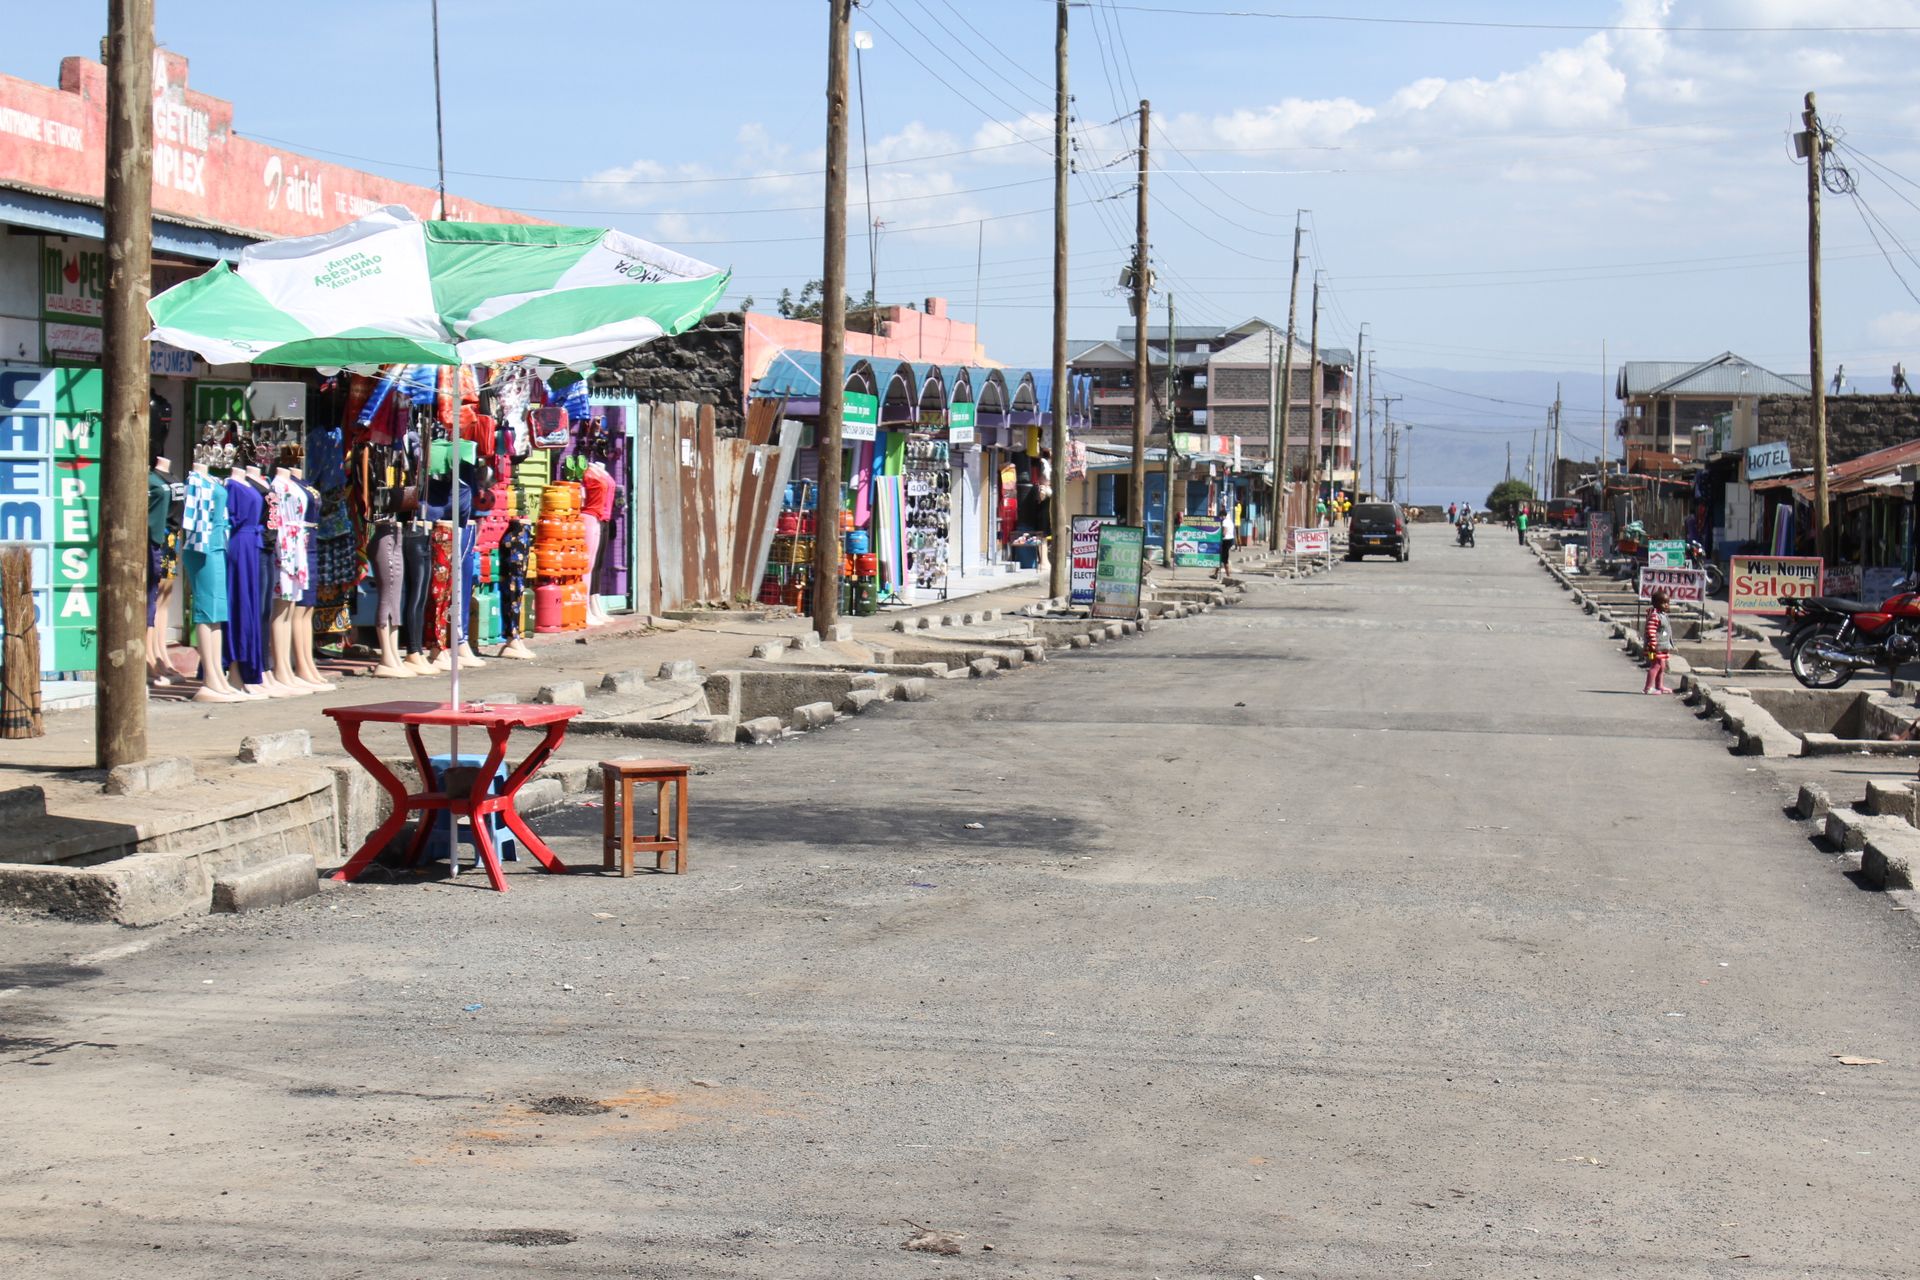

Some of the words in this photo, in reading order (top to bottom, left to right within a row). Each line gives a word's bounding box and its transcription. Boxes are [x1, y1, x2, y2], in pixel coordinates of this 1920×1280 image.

[285, 165, 324, 219] airtel
[350, 254, 383, 272] own
[360, 265, 383, 278] Pay
[314, 267, 350, 287] easy
[1747, 450, 1788, 470] HOTEL
[910, 483, 928, 494] 400
[1296, 531, 1328, 543] CHEMIST
[1112, 548, 1140, 563] KCB
[1747, 561, 1772, 576] Wa
[1777, 562, 1819, 579] Nonny
[1735, 575, 1817, 597] Salon
